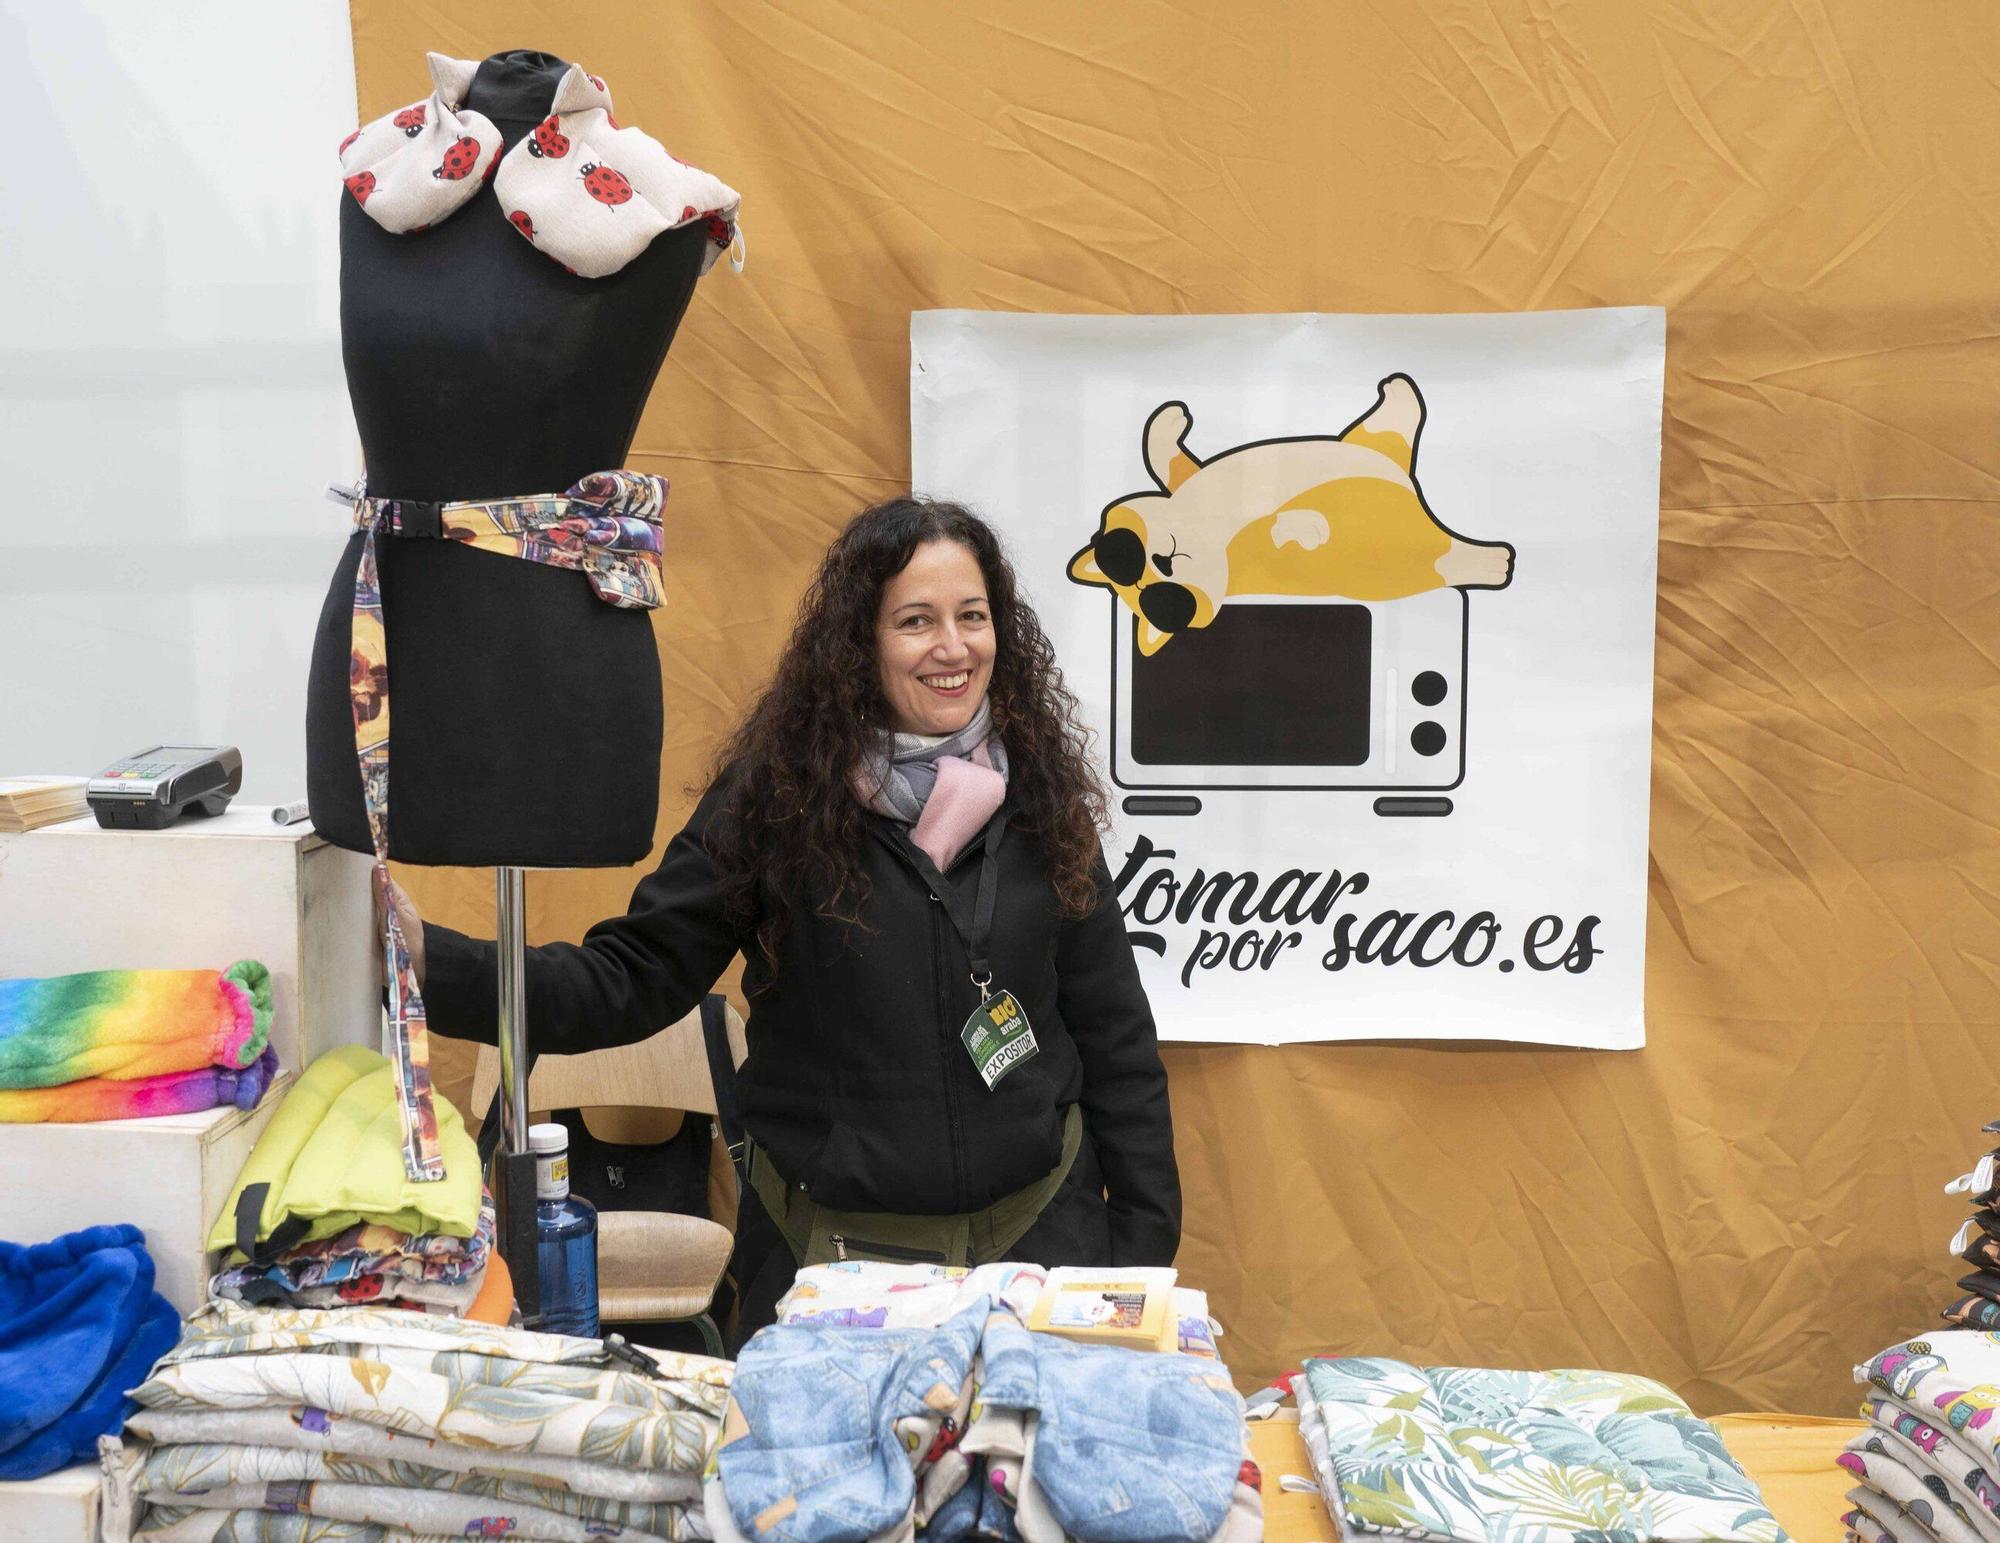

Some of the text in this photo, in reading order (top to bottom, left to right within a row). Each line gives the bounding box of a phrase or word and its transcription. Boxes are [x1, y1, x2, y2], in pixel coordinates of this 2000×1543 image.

[1113, 834, 1369, 926] tomar
[1181, 909, 1605, 989] por saco.es
[990, 995, 1016, 1025] BIO
[1000, 1016, 1022, 1035] araba
[986, 1034, 1033, 1079] EXPOSITOR
